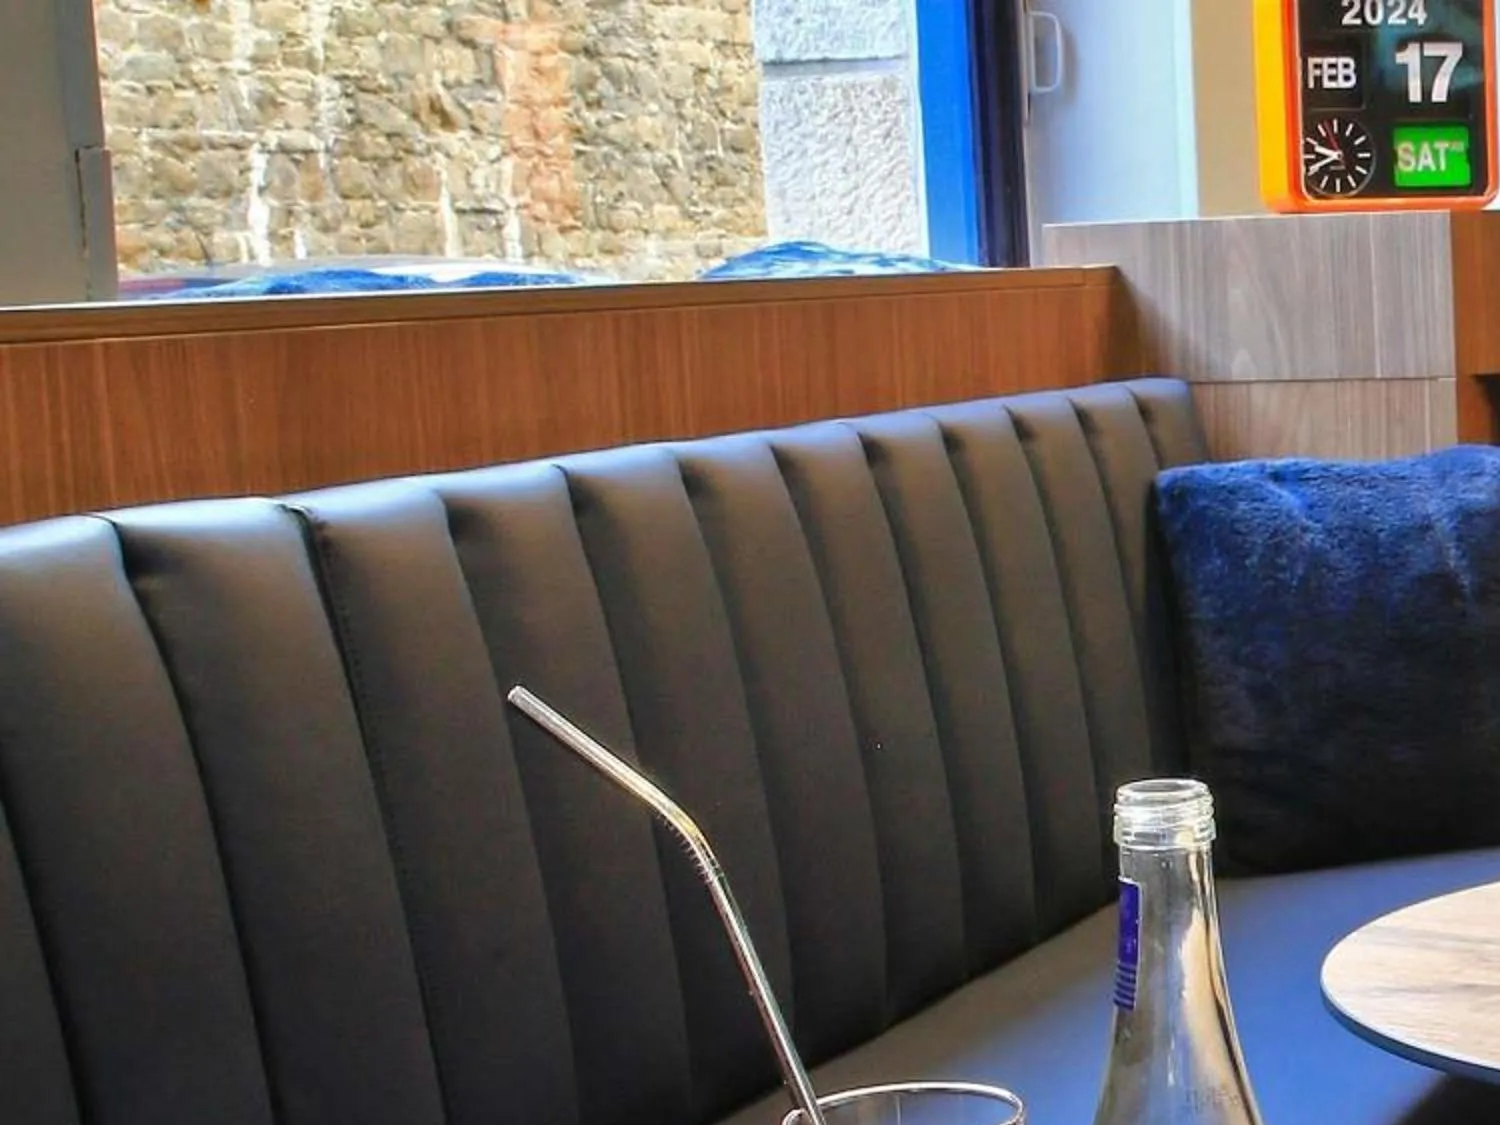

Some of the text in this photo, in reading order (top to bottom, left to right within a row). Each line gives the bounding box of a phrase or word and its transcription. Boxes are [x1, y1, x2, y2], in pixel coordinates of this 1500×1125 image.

[1341, 0, 1428, 25] 2024
[1307, 56, 1357, 89] FEB
[1395, 41, 1463, 103] 17
[1397, 141, 1447, 172] SAT
